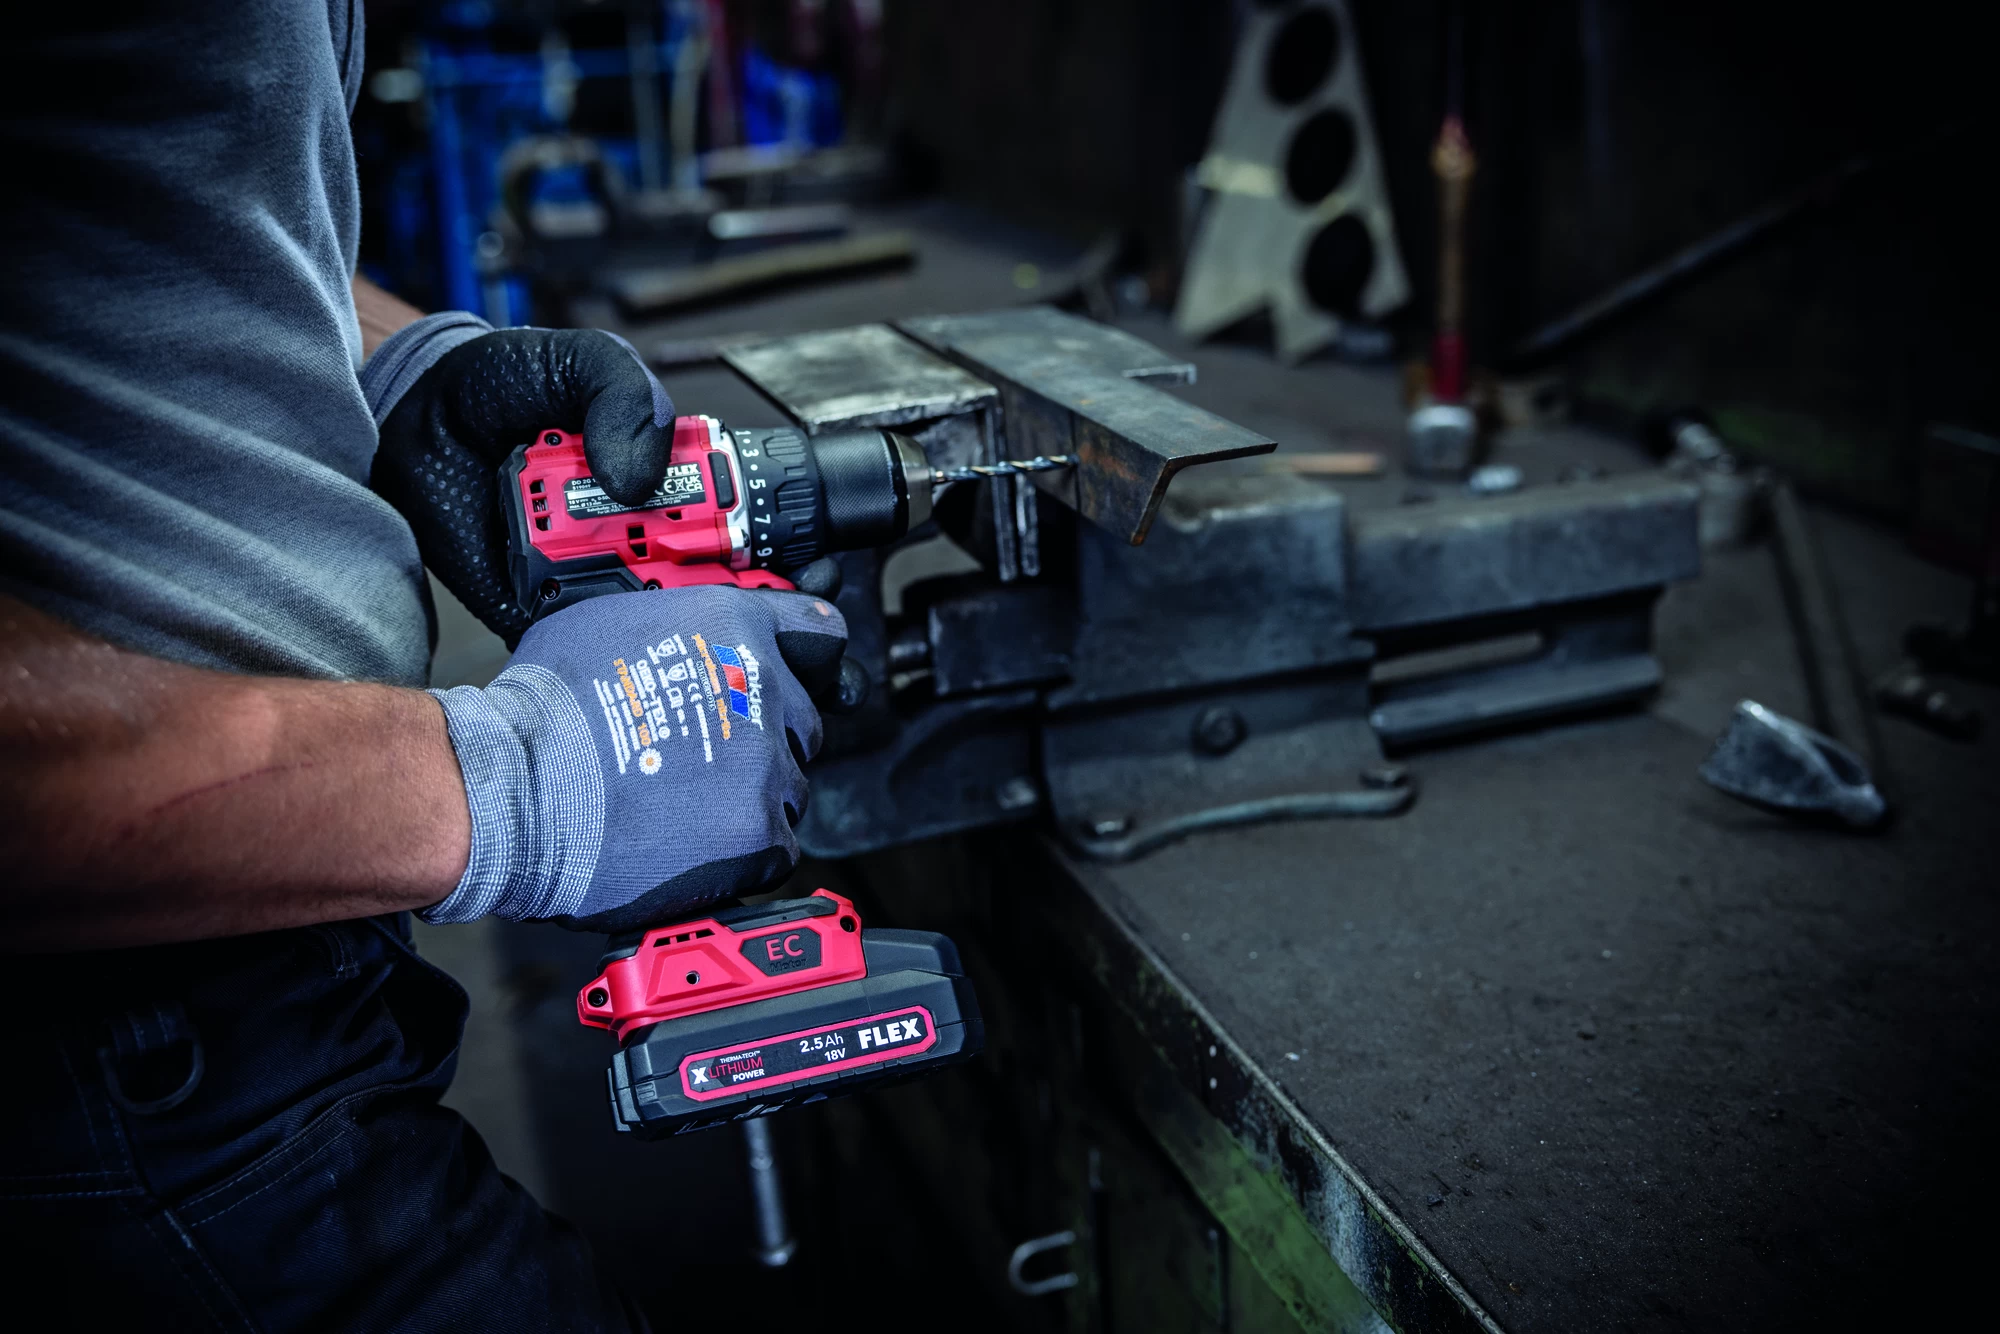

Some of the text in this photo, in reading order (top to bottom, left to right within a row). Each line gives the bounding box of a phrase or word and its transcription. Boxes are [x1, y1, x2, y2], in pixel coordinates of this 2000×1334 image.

[742, 448, 759, 458] 3
[667, 463, 699, 477] FLEX
[684, 475, 701, 484] UK
[749, 478, 766, 490] 5
[686, 482, 703, 492] CA
[754, 513, 771, 525] 7
[757, 547, 773, 557] 9
[637, 660, 668, 727] OEKO-TEX
[736, 643, 764, 731] winkler
[613, 658, 652, 746] STANDARD 100
[766, 934, 804, 961] EC
[770, 958, 806, 973] Motor
[858, 1018, 922, 1050] FLEX
[824, 1047, 846, 1062] 18V
[691, 1056, 763, 1085] X LITHIUM
[732, 1068, 765, 1082] POWER
